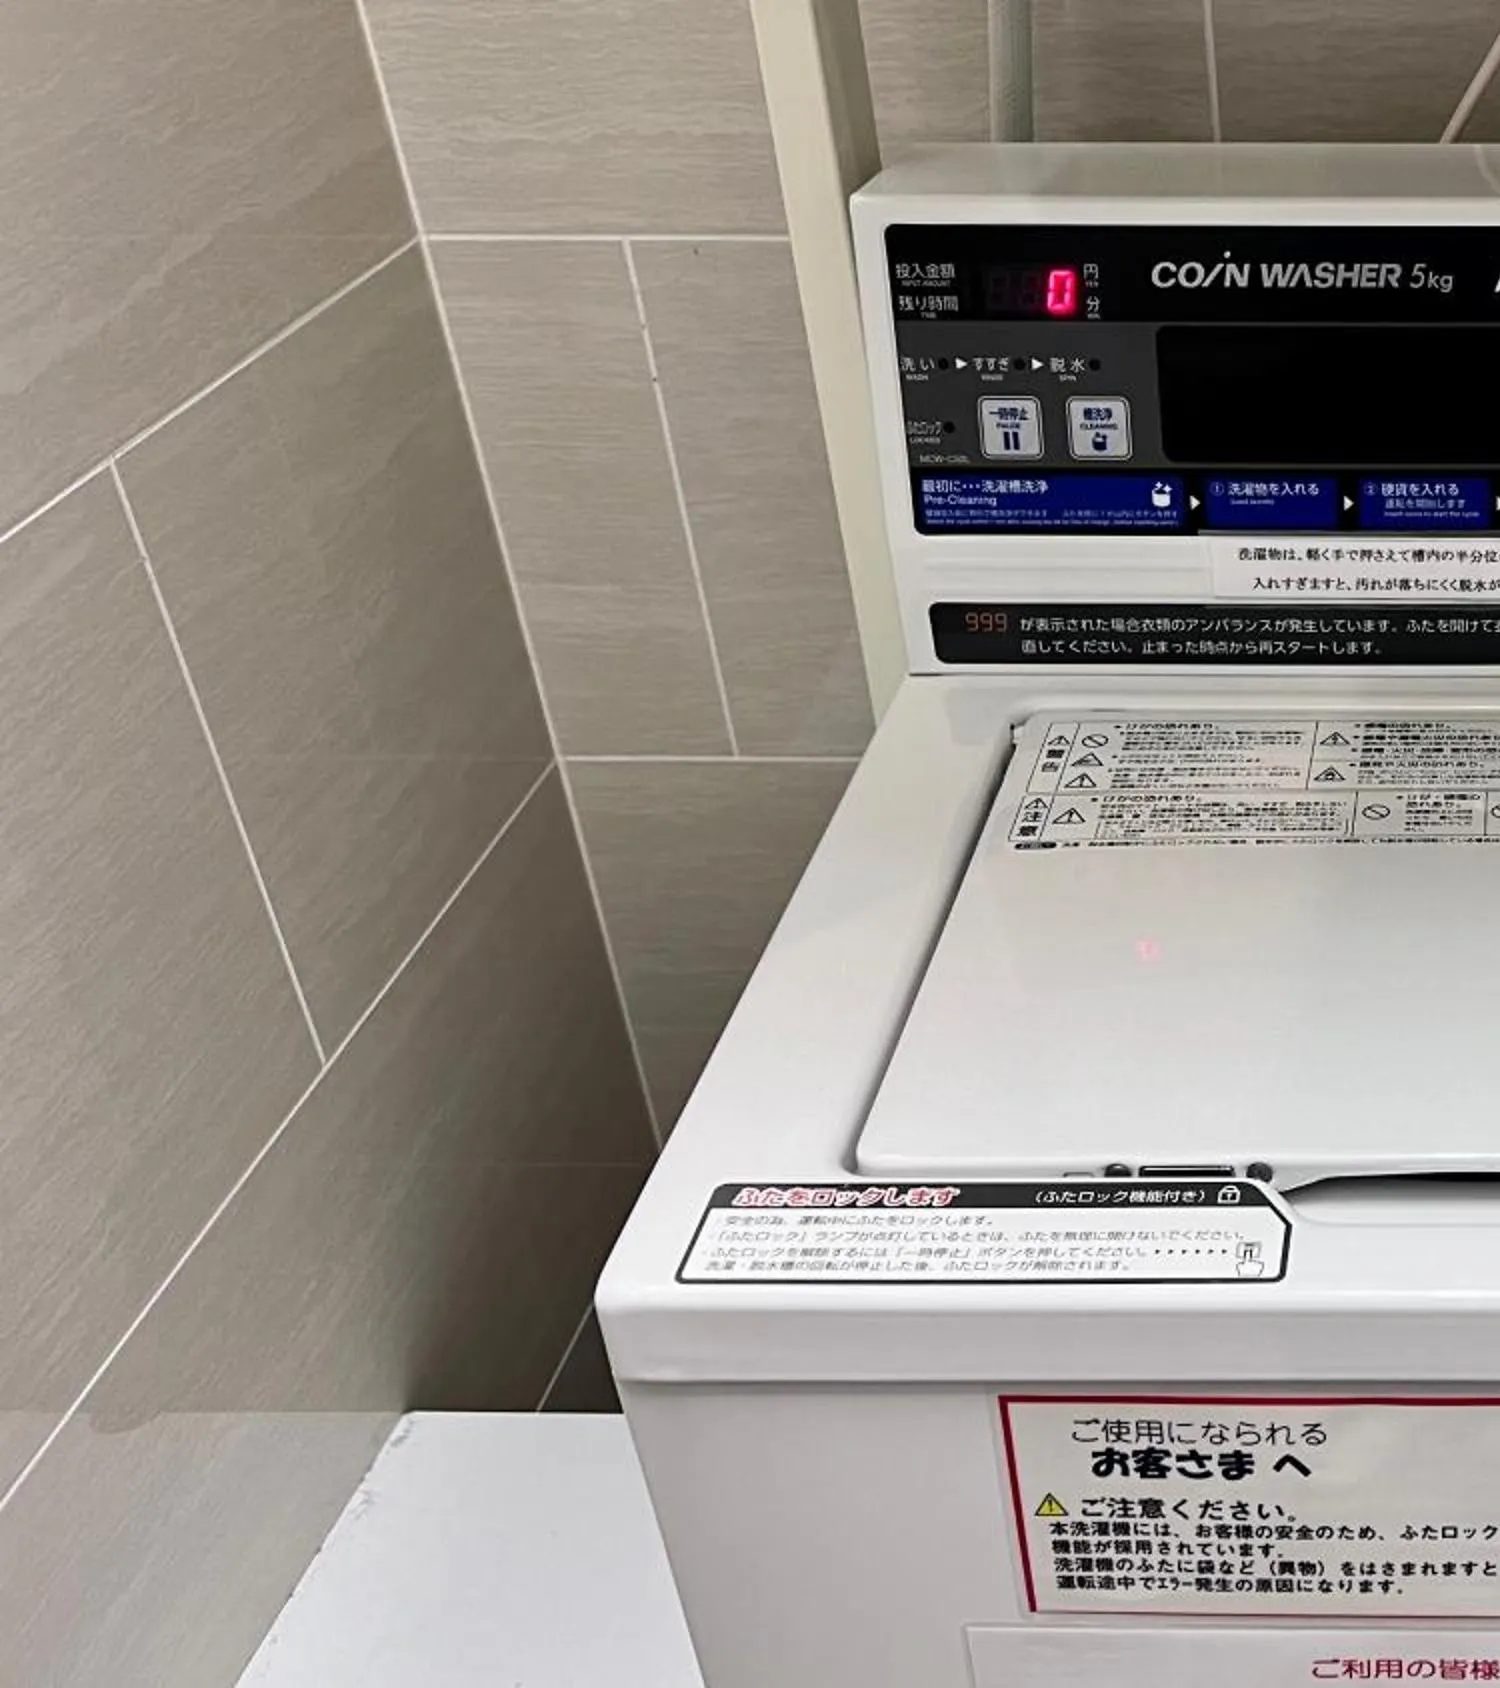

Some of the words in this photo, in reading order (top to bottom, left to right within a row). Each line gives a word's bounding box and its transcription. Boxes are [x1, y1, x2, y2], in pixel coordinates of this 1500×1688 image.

[896, 263, 955, 279] 投入金額
[1083, 264, 1099, 279] 円
[1151, 251, 1249, 288] COIN
[1260, 263, 1402, 288] WASHER
[1409, 263, 1454, 293] 5kg
[1047, 269, 1076, 314] 0
[899, 295, 959, 311] 残り時間
[1086, 296, 1100, 312] 分
[973, 357, 1010, 372] すすぎ
[924, 494, 997, 507] Pre-Cleaning
[965, 612, 1007, 632] 999
[732, 1188, 960, 1206] ふたをロックします
[1071, 1418, 1328, 1446] ご使用になられる
[1080, 1498, 1298, 1523] ご注意ください。
[1051, 1539, 1284, 1559] 機能が採用されています。
